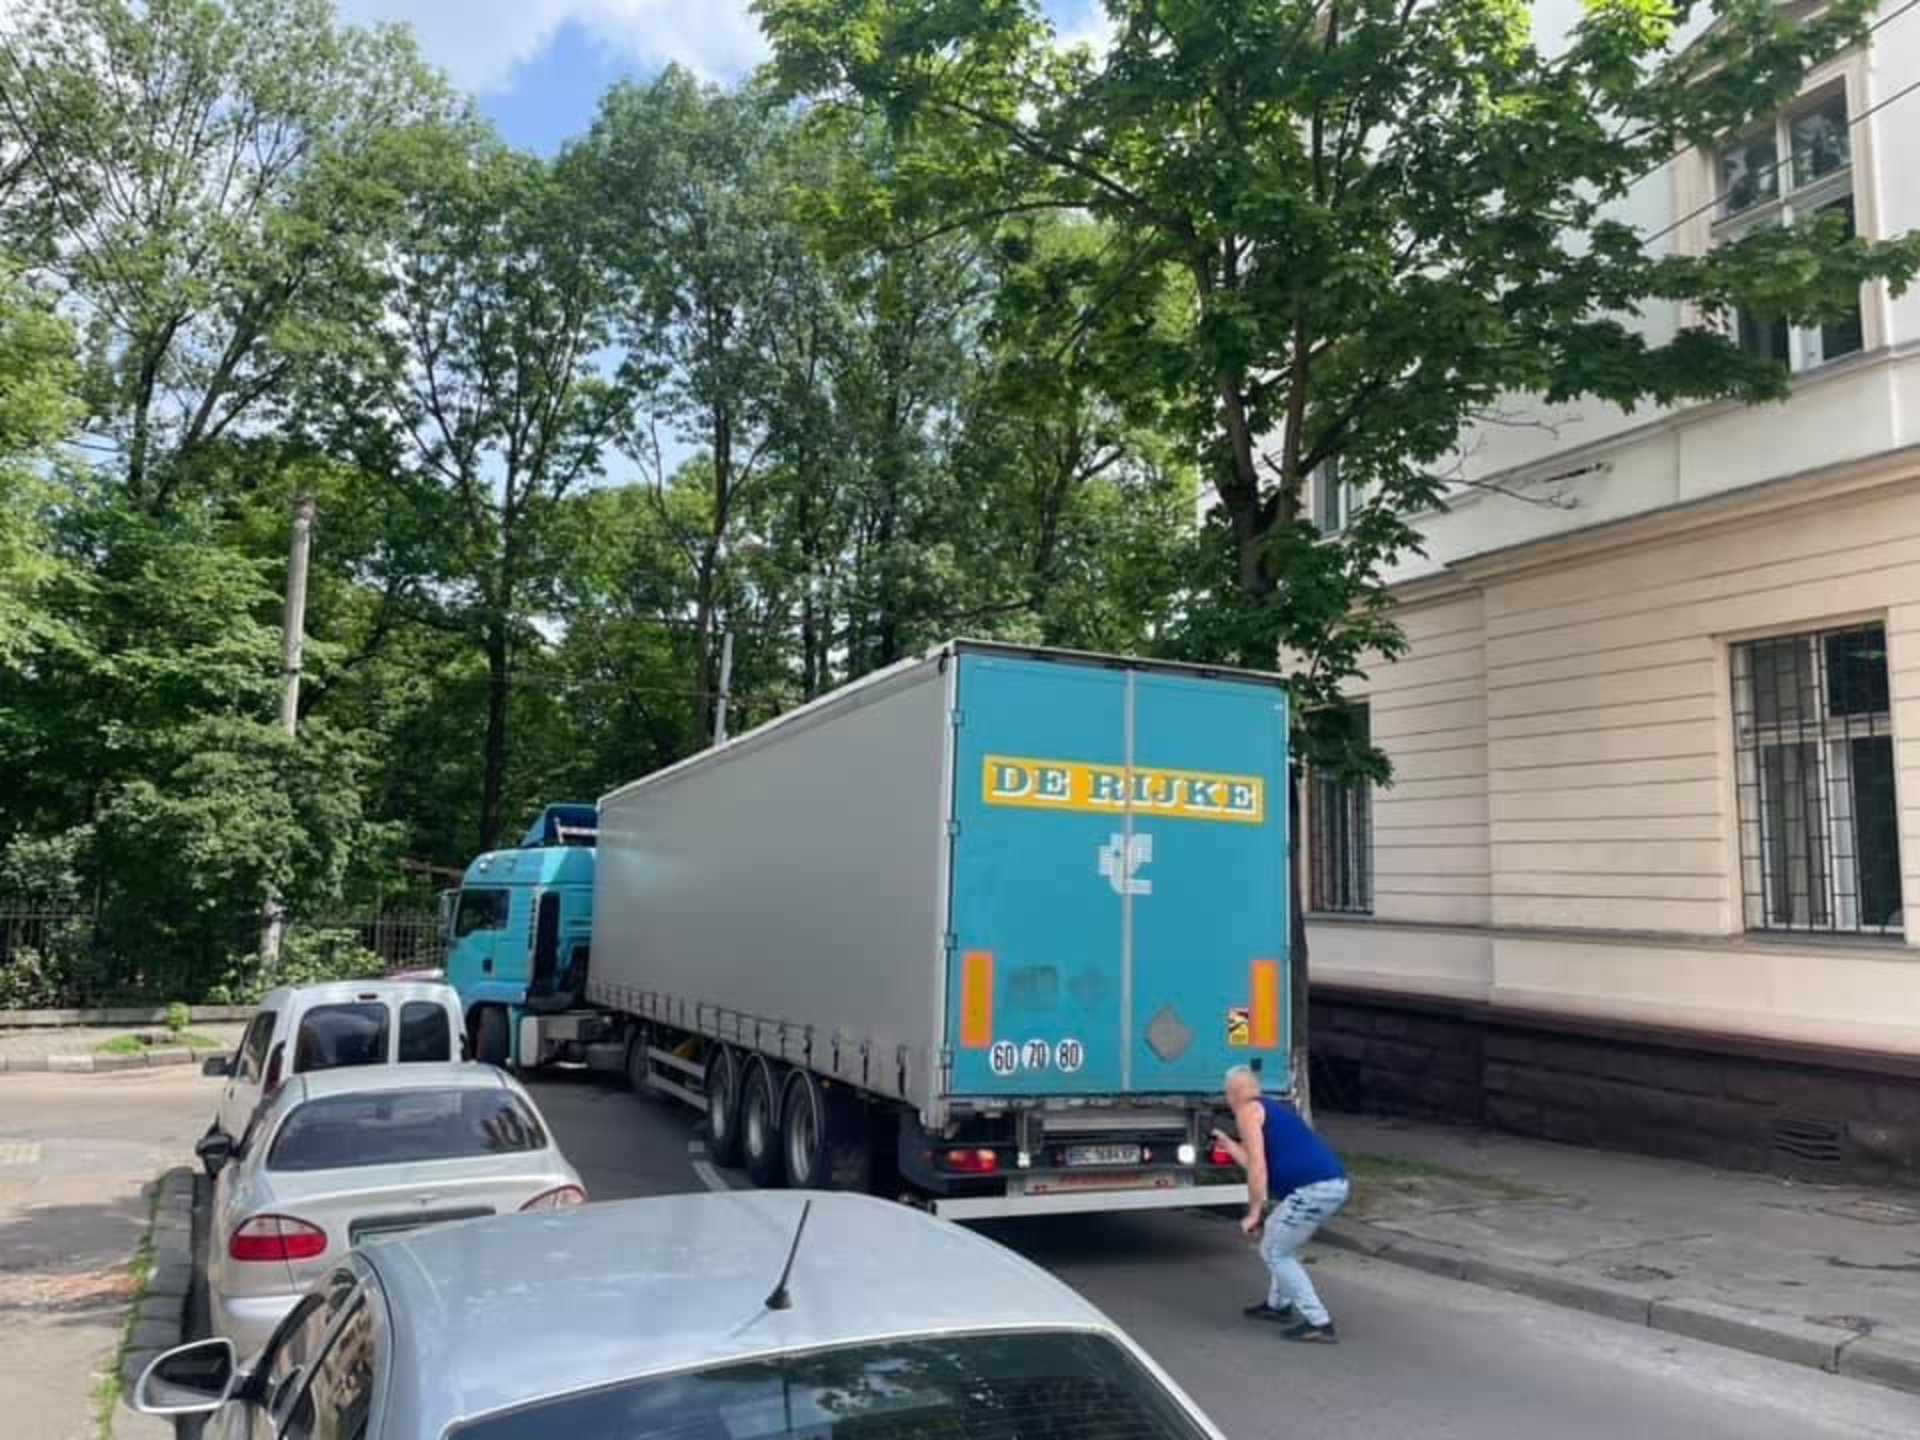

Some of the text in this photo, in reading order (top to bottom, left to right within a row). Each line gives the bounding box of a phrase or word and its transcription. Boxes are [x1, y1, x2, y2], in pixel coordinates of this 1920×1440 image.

[991, 764, 1257, 813] DE RIJKE
[993, 1042, 1079, 1071] 60 70 80
